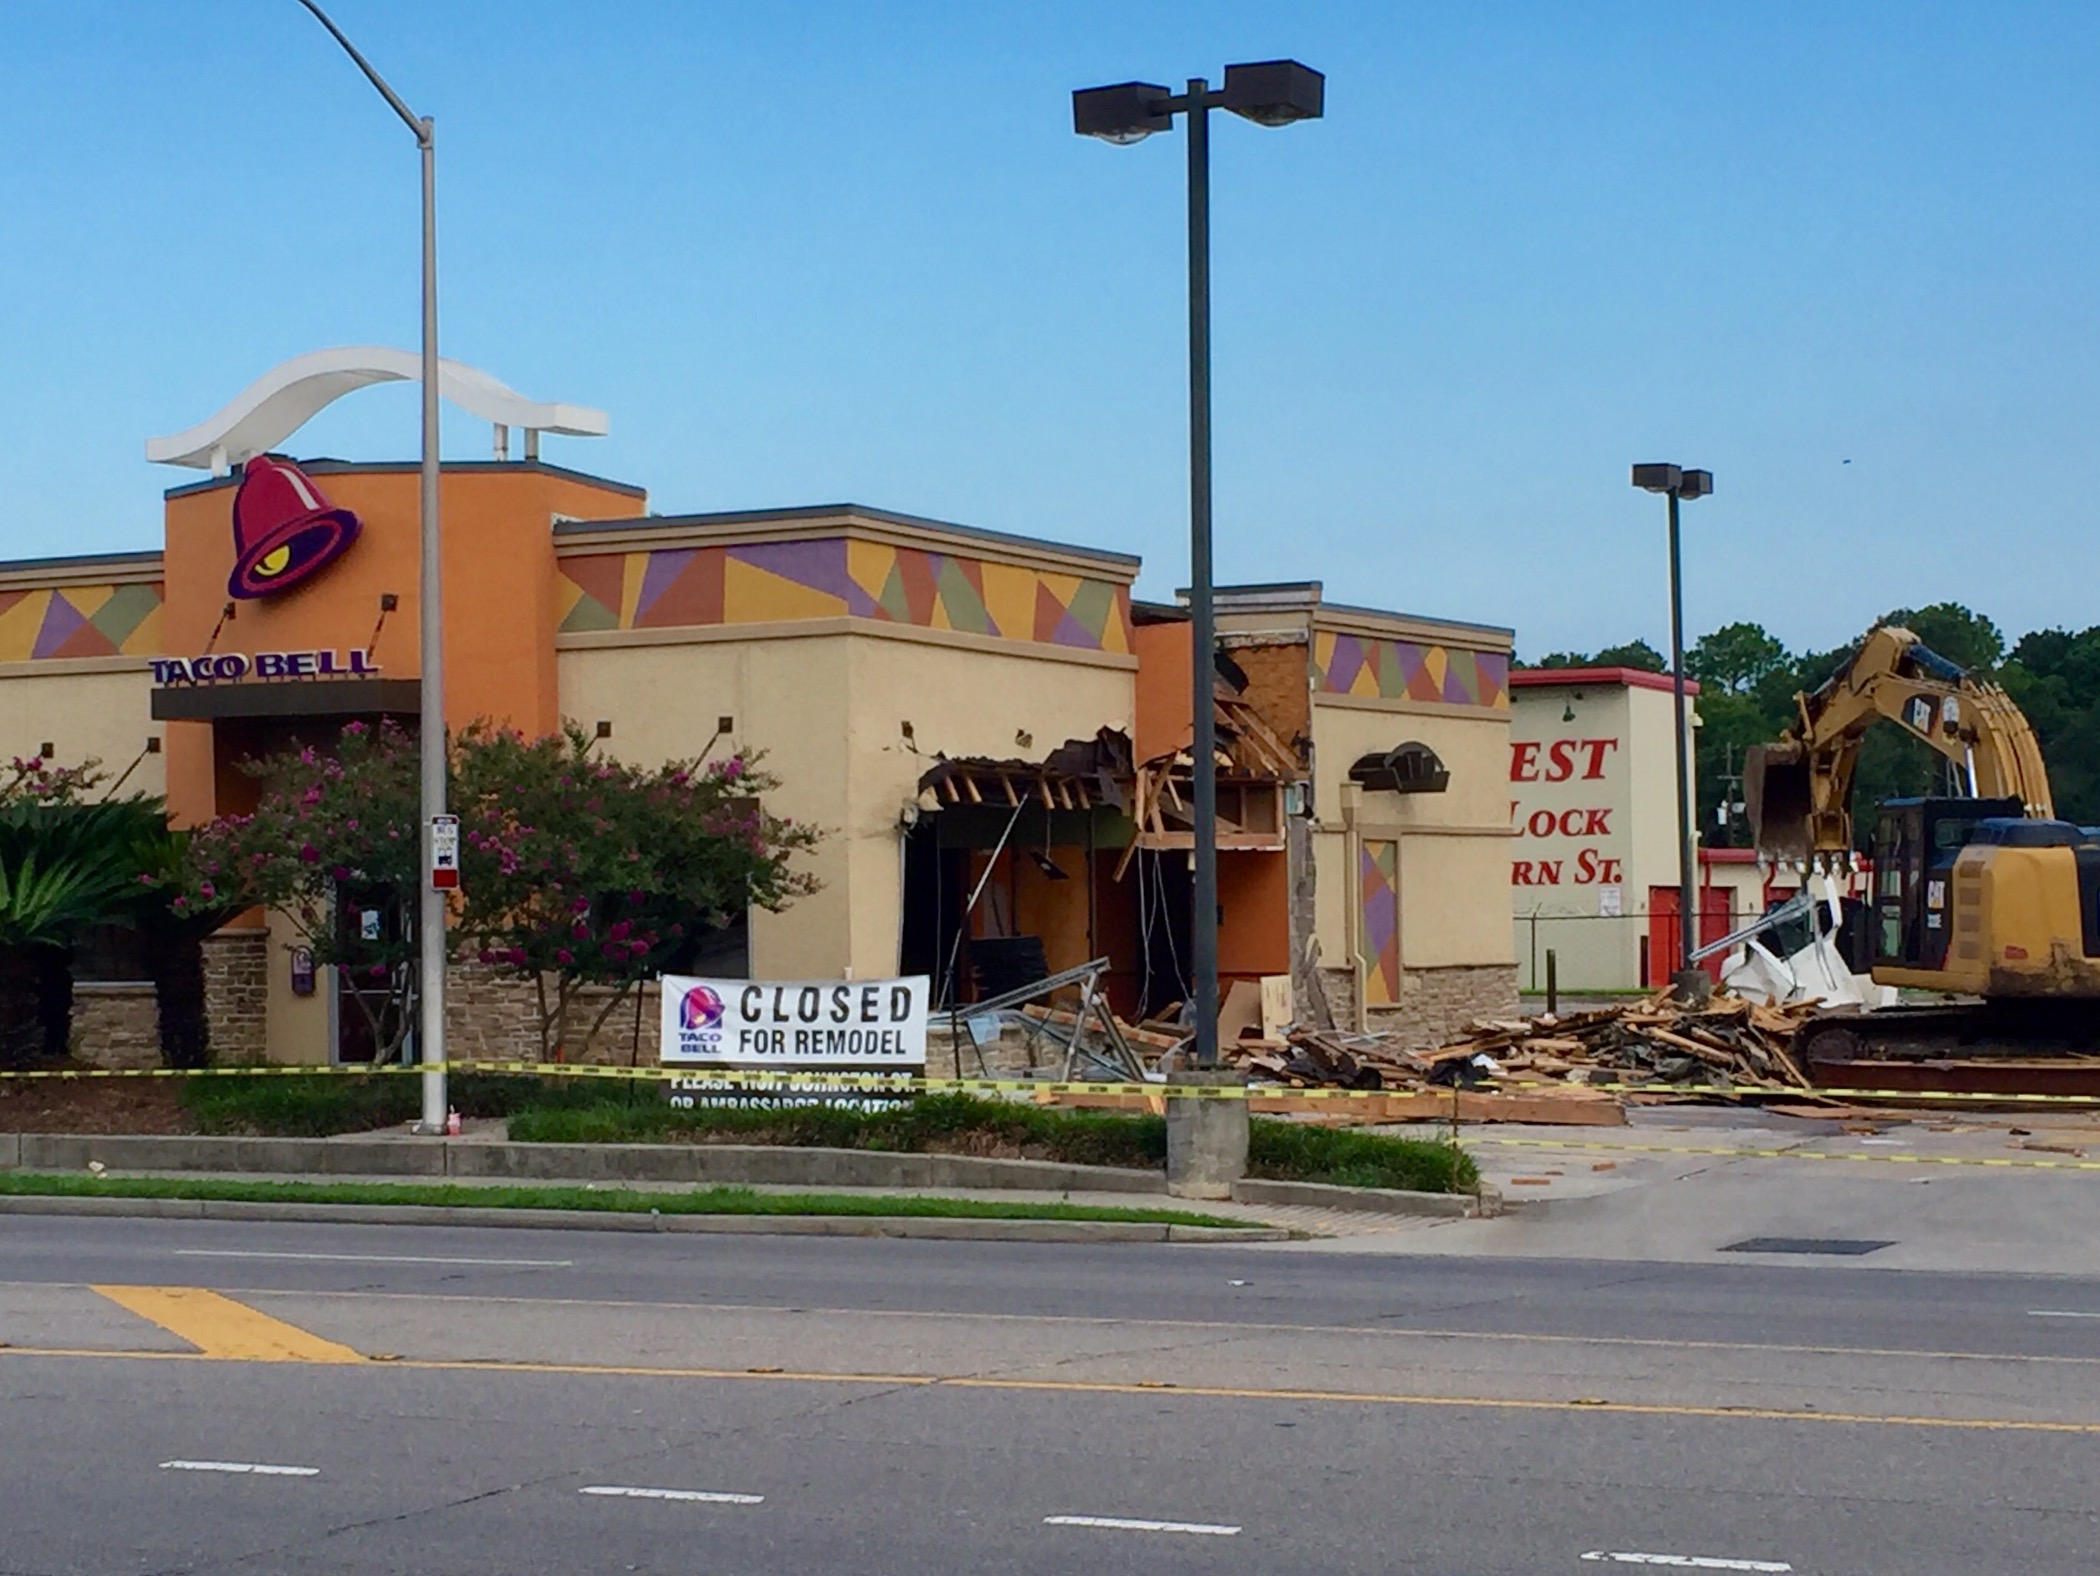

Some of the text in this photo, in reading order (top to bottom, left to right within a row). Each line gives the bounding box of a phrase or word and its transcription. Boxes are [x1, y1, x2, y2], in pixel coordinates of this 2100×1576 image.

[149, 649, 382, 683] TACO BELL
[740, 985, 912, 1023] CLOSED
[679, 1032, 722, 1042] TACO
[680, 1043, 721, 1054] BELL
[739, 1029, 907, 1055] FOR REMODEL
